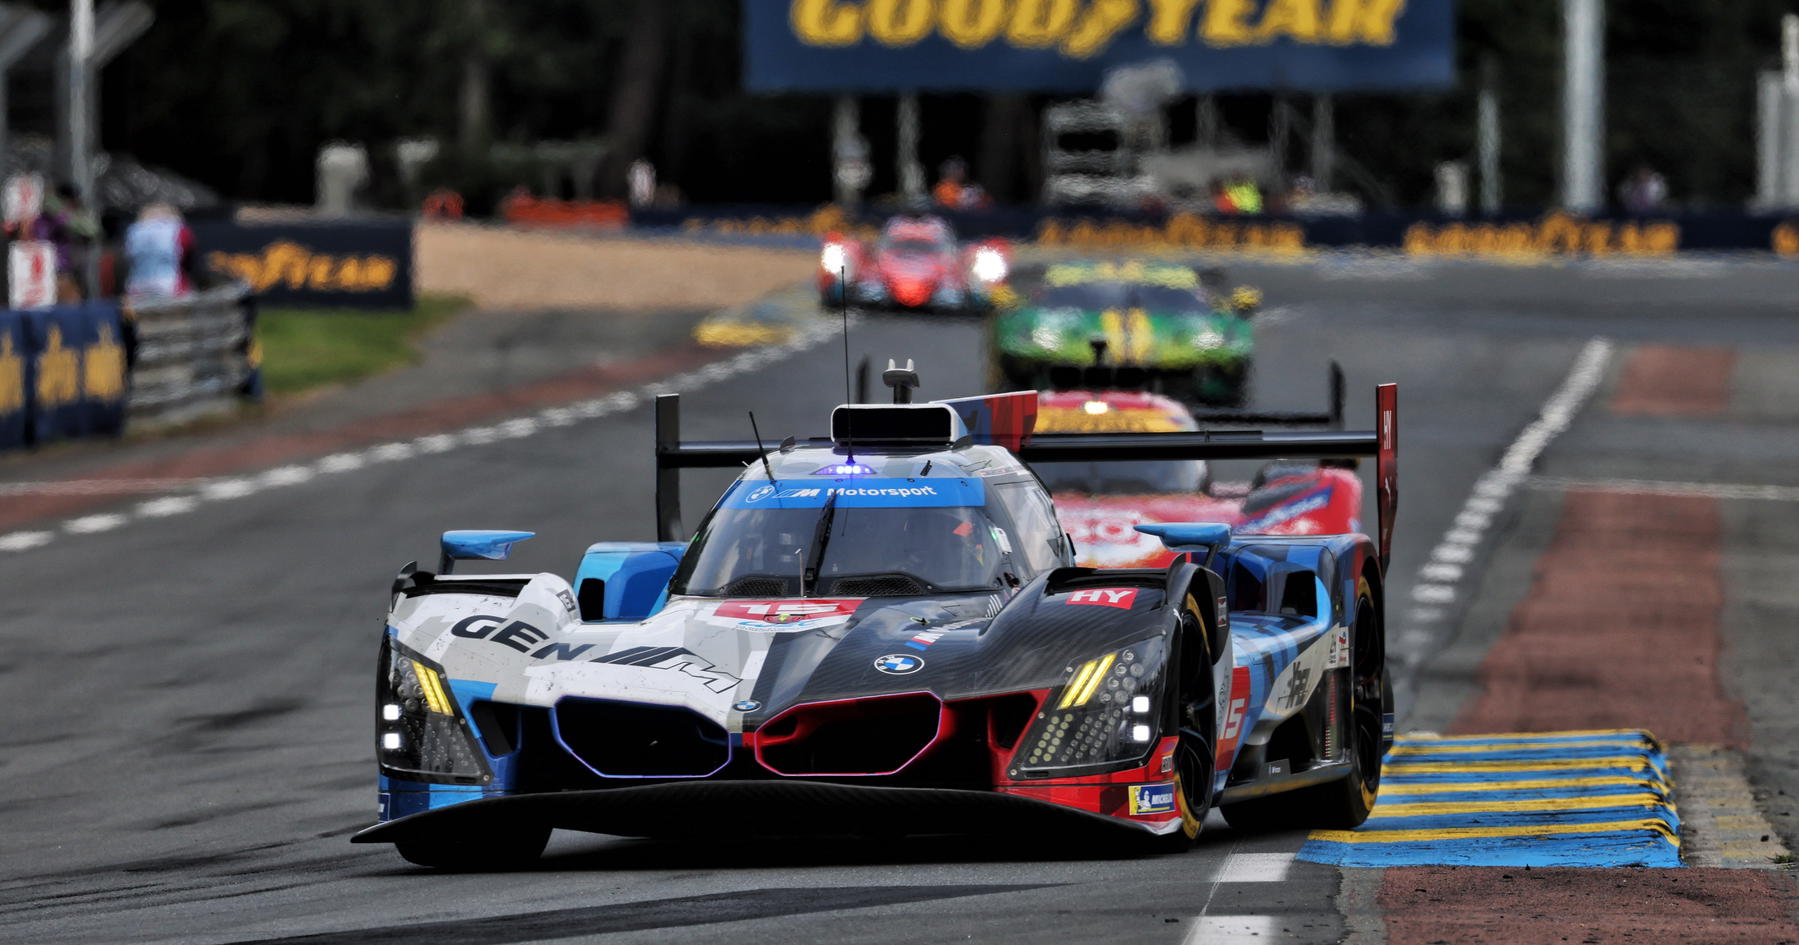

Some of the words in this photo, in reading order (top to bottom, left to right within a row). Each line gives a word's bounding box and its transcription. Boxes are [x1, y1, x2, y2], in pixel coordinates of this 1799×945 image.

[790, 0, 1402, 59] GOODYEAR
[827, 485, 937, 498] Motorsport
[1071, 589, 1133, 604] HY
[450, 614, 595, 660] GEN
